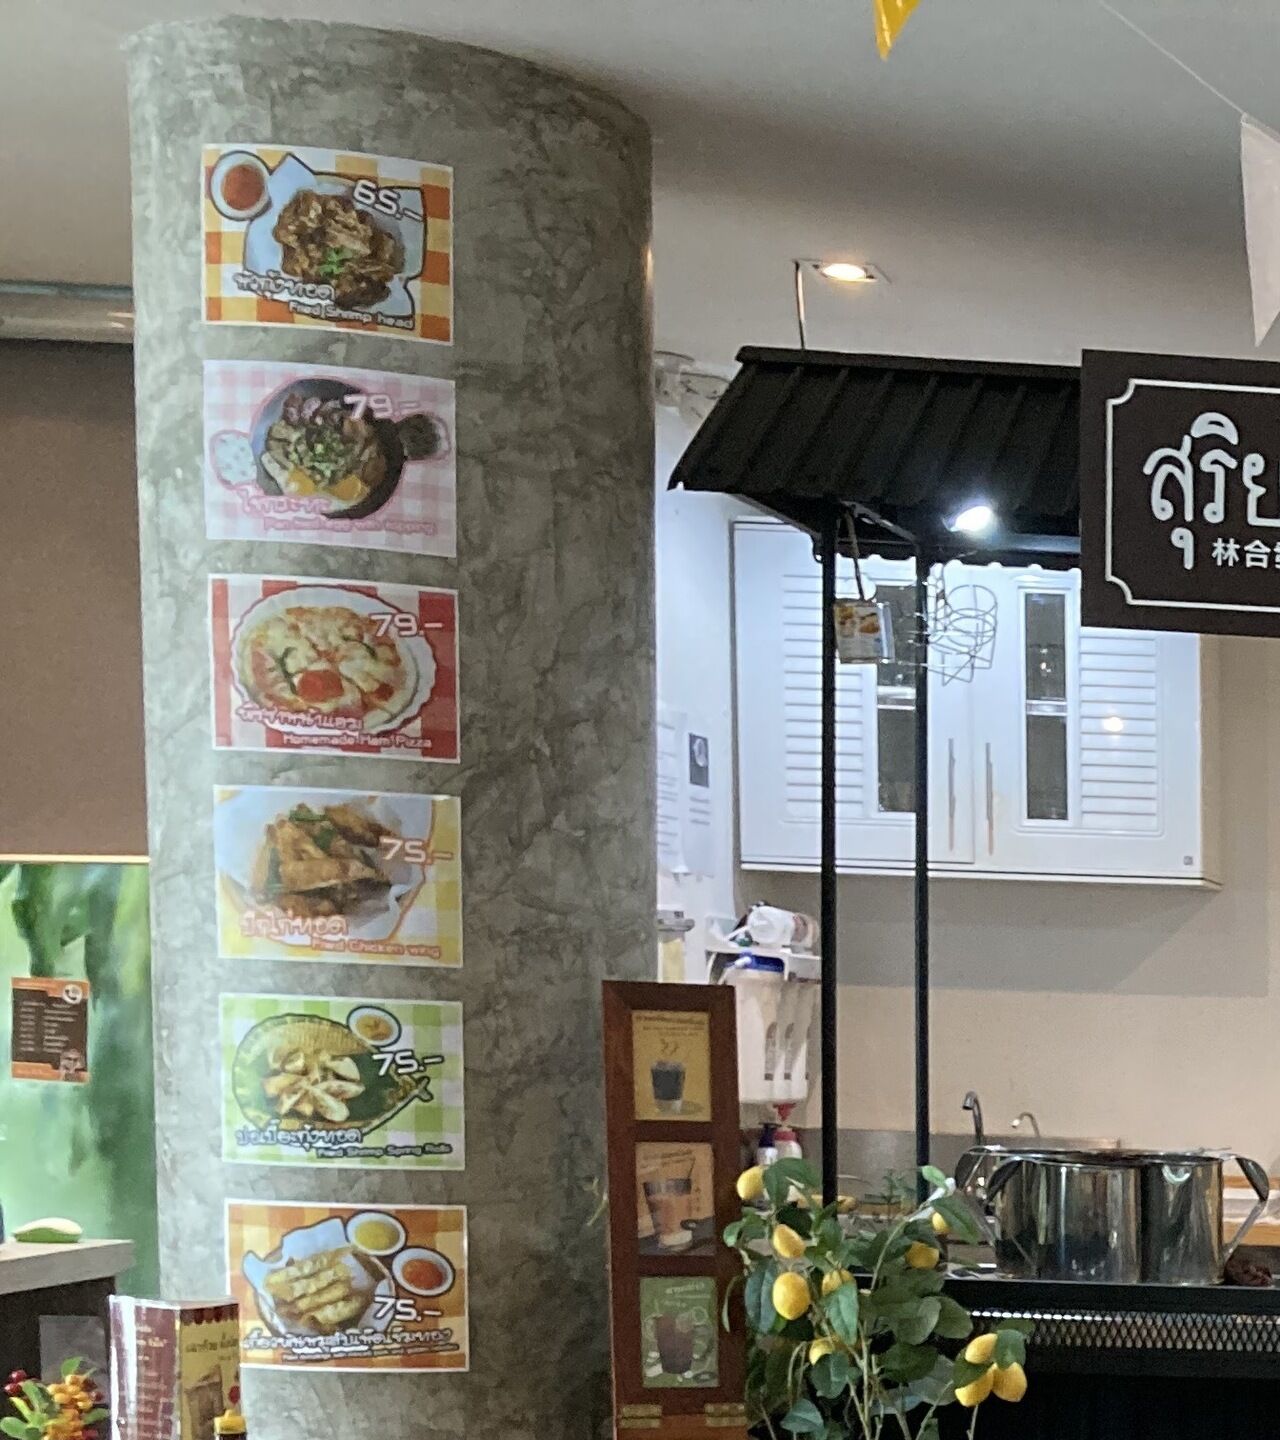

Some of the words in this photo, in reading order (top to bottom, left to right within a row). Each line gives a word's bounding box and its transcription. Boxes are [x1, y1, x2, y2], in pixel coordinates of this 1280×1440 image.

[369, 612, 443, 637] 79.-
[379, 837, 453, 863] 75.-
[372, 1050, 444, 1076] 75.-
[374, 1296, 442, 1322] 75.-
